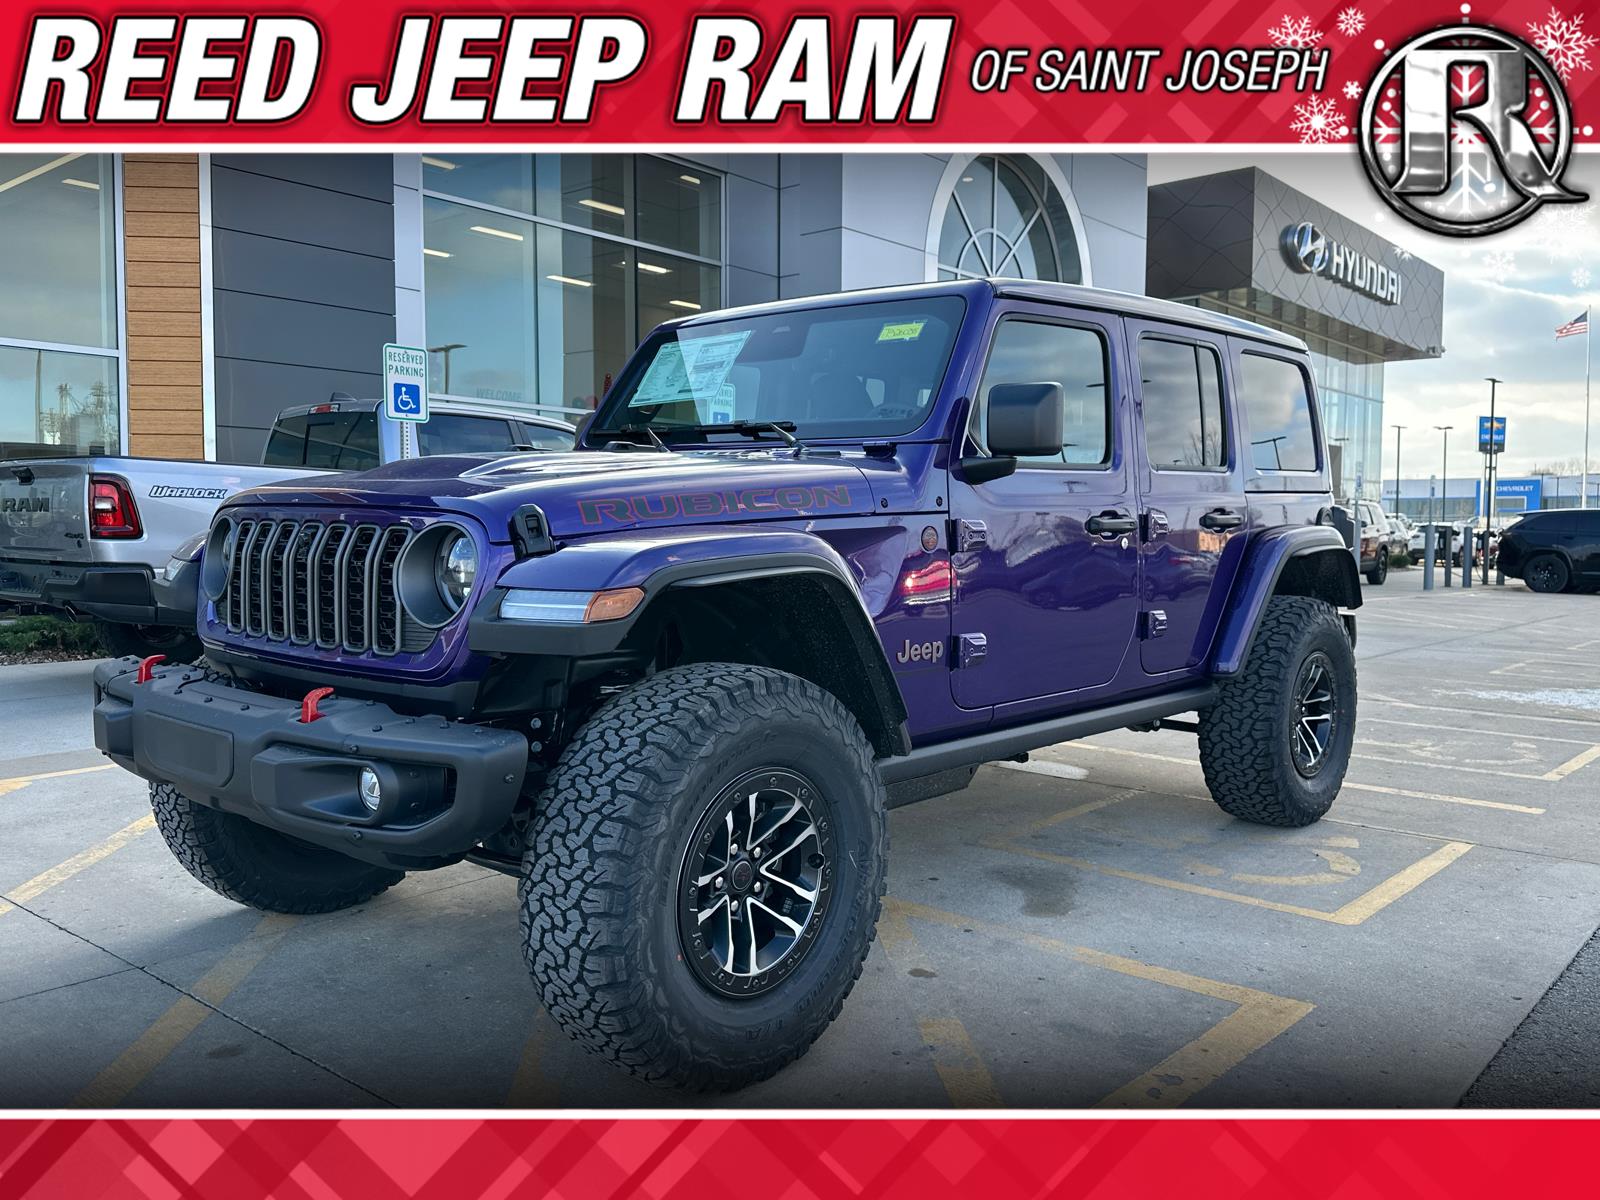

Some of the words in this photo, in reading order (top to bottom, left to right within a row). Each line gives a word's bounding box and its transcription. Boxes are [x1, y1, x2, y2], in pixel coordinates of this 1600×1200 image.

[1331, 240, 1402, 305] HYUNDAI
[388, 352, 424, 365] RESERVED
[388, 365, 424, 378] PARKING
[476, 387, 525, 401] WELCOME
[149, 485, 228, 499] WARLOCK
[2, 497, 50, 512] RAM
[578, 485, 851, 525] RUBICON
[896, 639, 944, 663] Jeep
